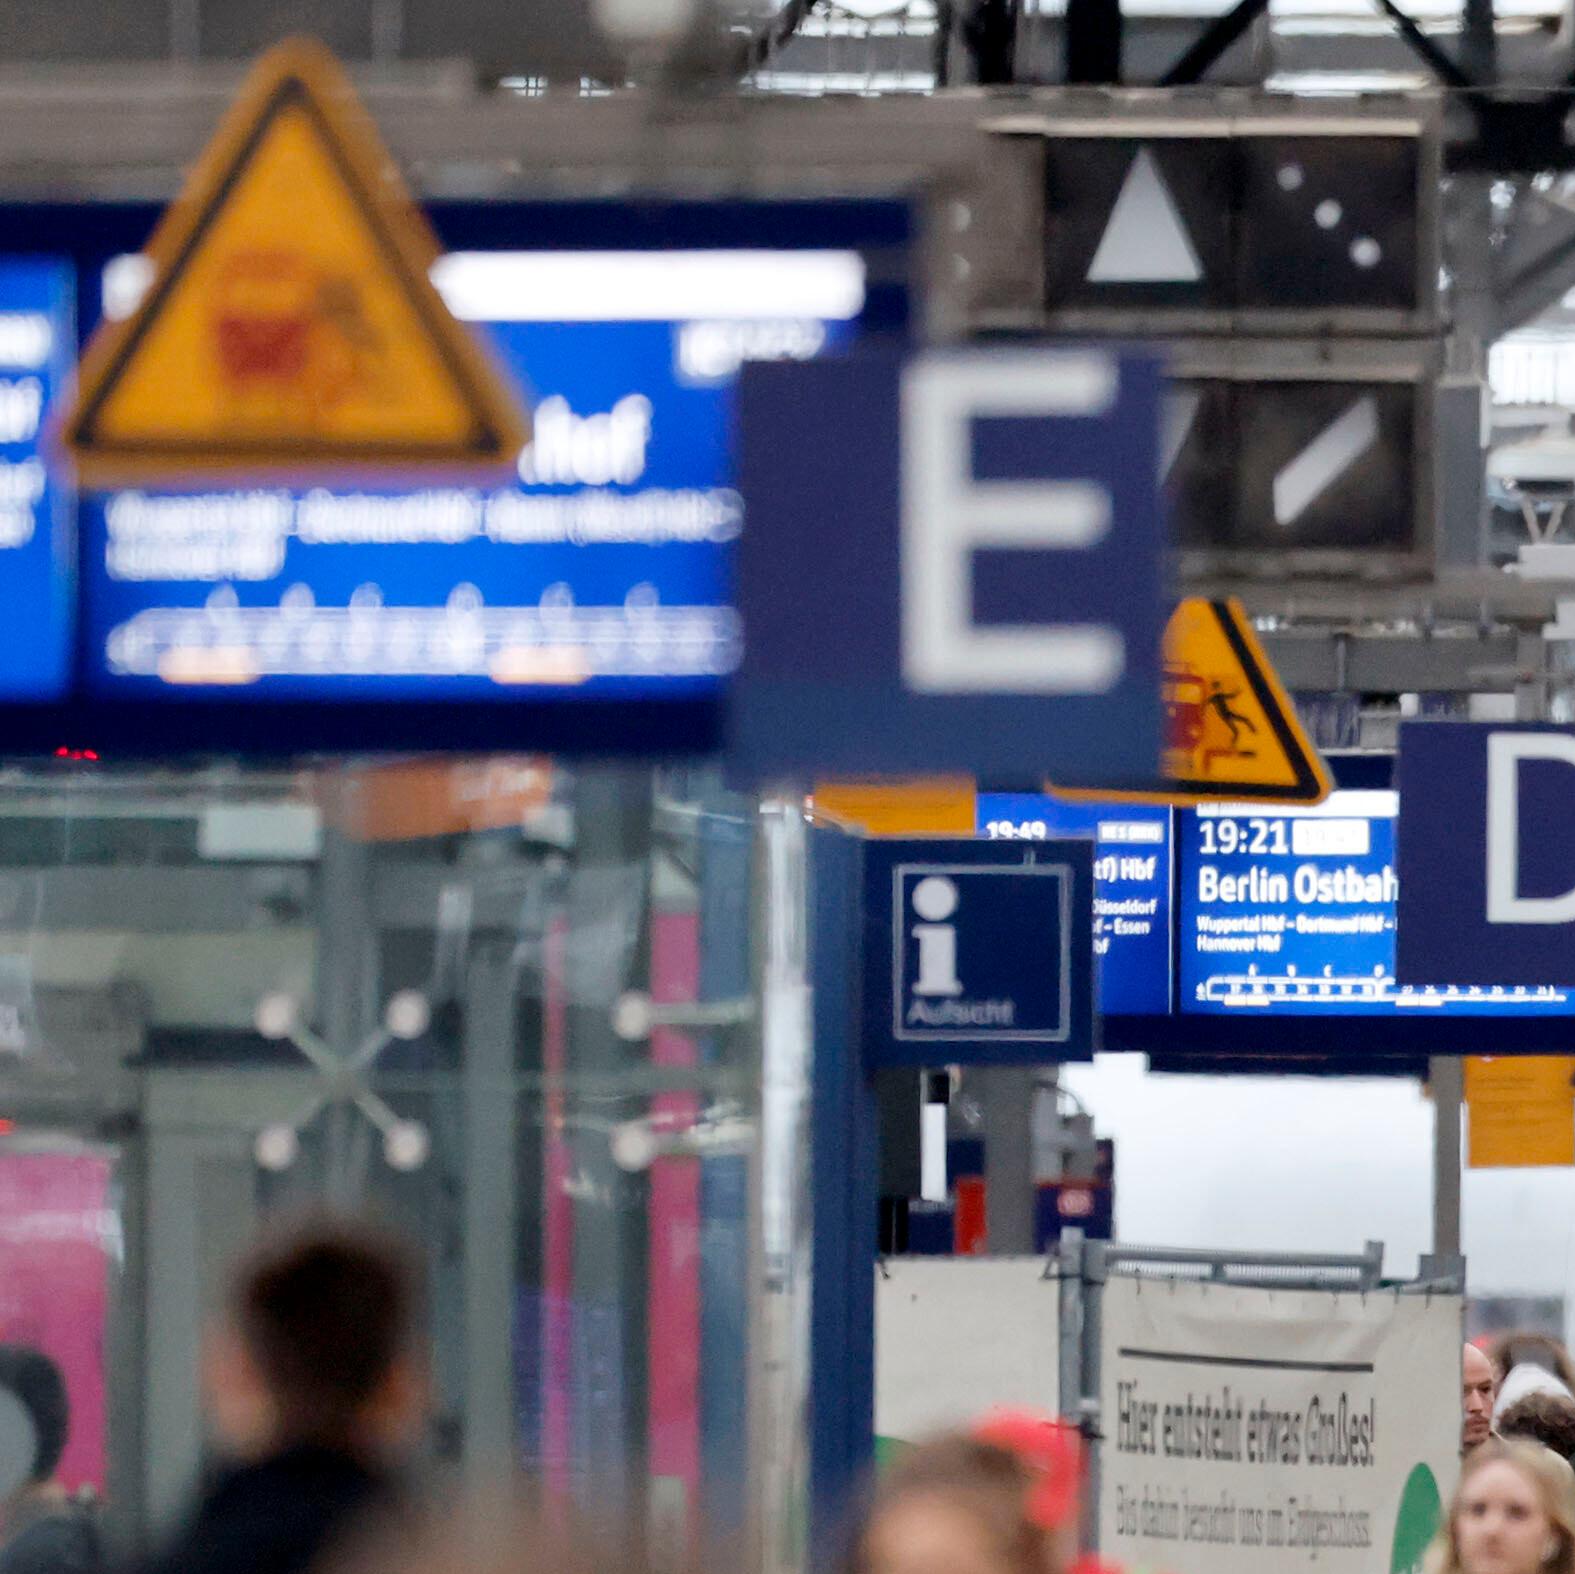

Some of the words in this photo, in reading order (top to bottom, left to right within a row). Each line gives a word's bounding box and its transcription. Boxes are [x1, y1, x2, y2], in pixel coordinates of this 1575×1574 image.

[899, 348, 1124, 696] E
[1199, 819, 1289, 855] 19:21
[1120, 856, 1156, 881] Hbf
[1199, 865, 1288, 903] Berlin
[1294, 864, 1399, 903] Ostbah
[1113, 918, 1150, 935] Essen
[1197, 914, 1260, 933] Wuppertal
[1261, 914, 1285, 932] Hbf
[1296, 914, 1358, 934] Dortmund
[1359, 914, 1384, 933] Hbf
[1197, 935, 1256, 952] Hannover
[1116, 1379, 1158, 1455] Hier
[1248, 1398, 1300, 1465] etwas
[1305, 1391, 1375, 1467] Großes!
